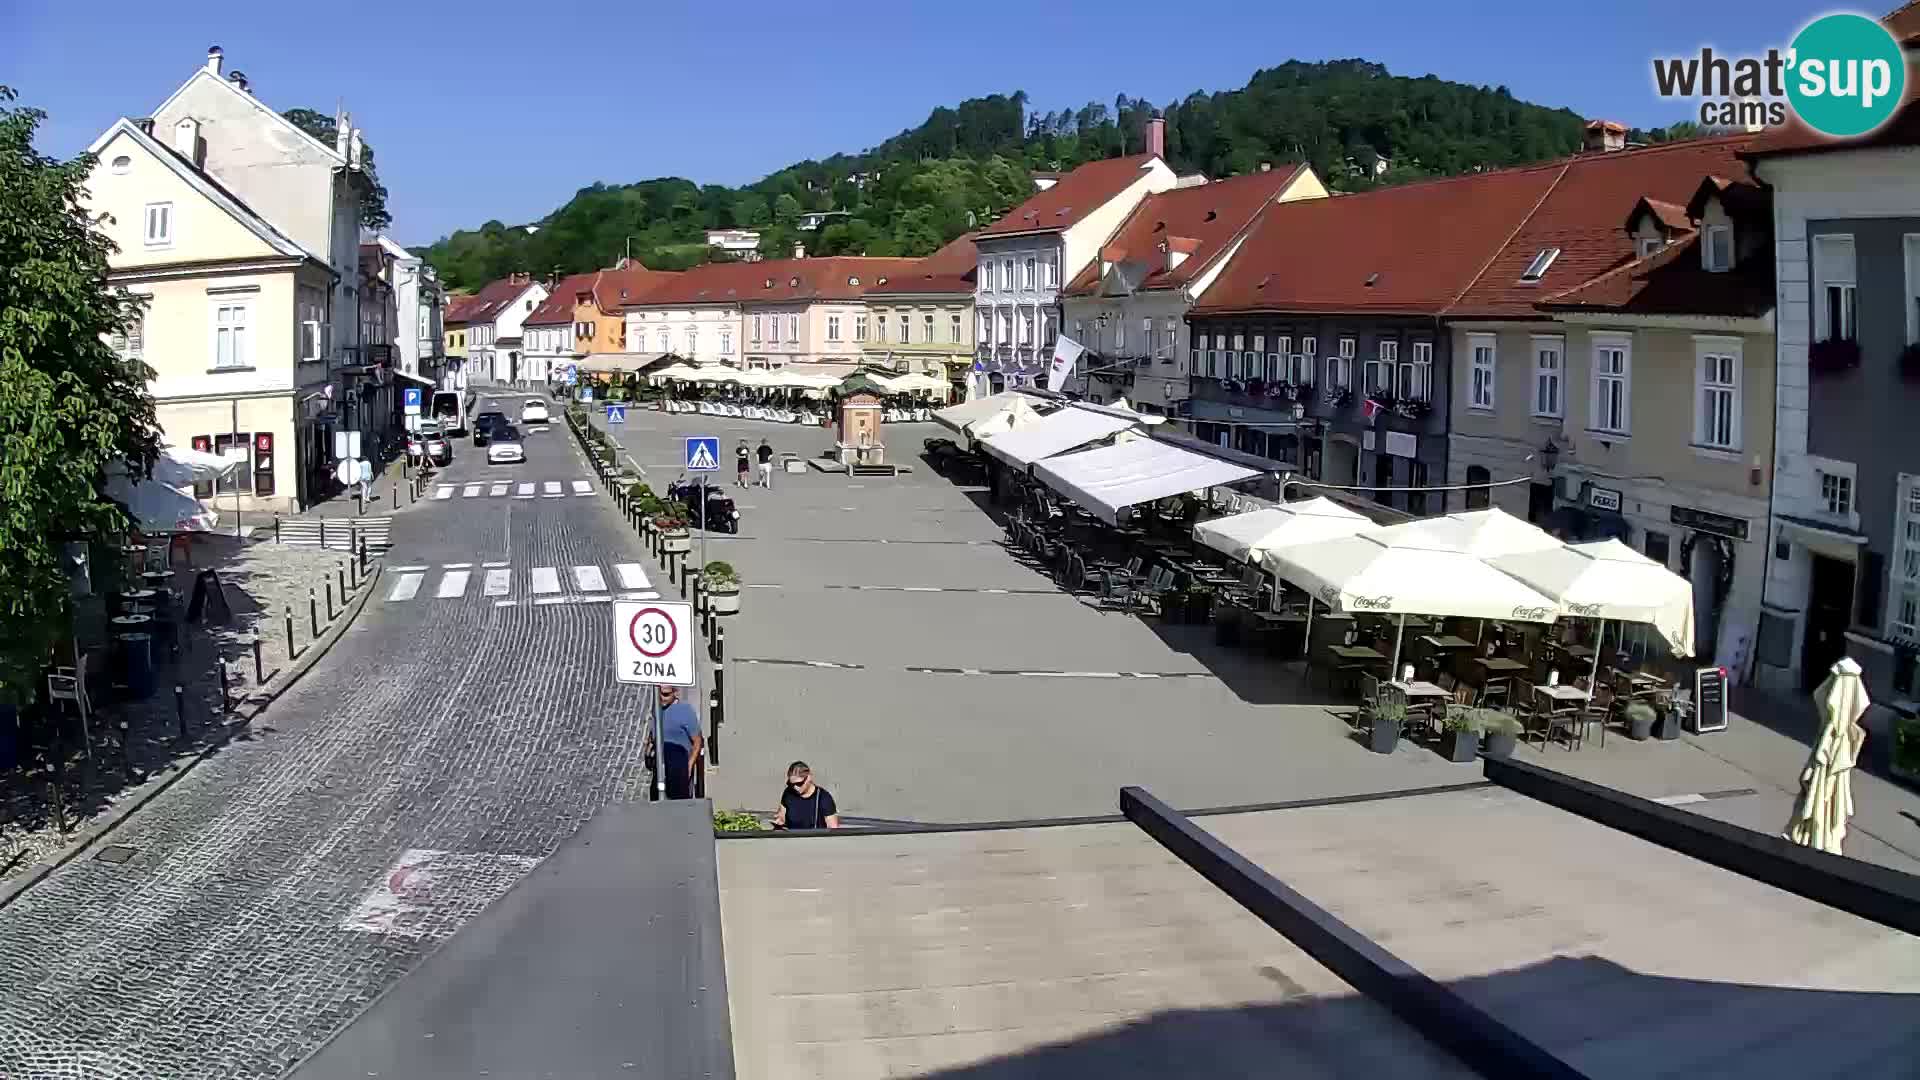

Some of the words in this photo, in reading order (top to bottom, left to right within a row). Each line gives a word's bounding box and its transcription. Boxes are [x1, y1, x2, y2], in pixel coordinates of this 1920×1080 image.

[408, 391, 417, 403] P
[642, 624, 666, 644] 30
[632, 661, 676, 677] ZONA
